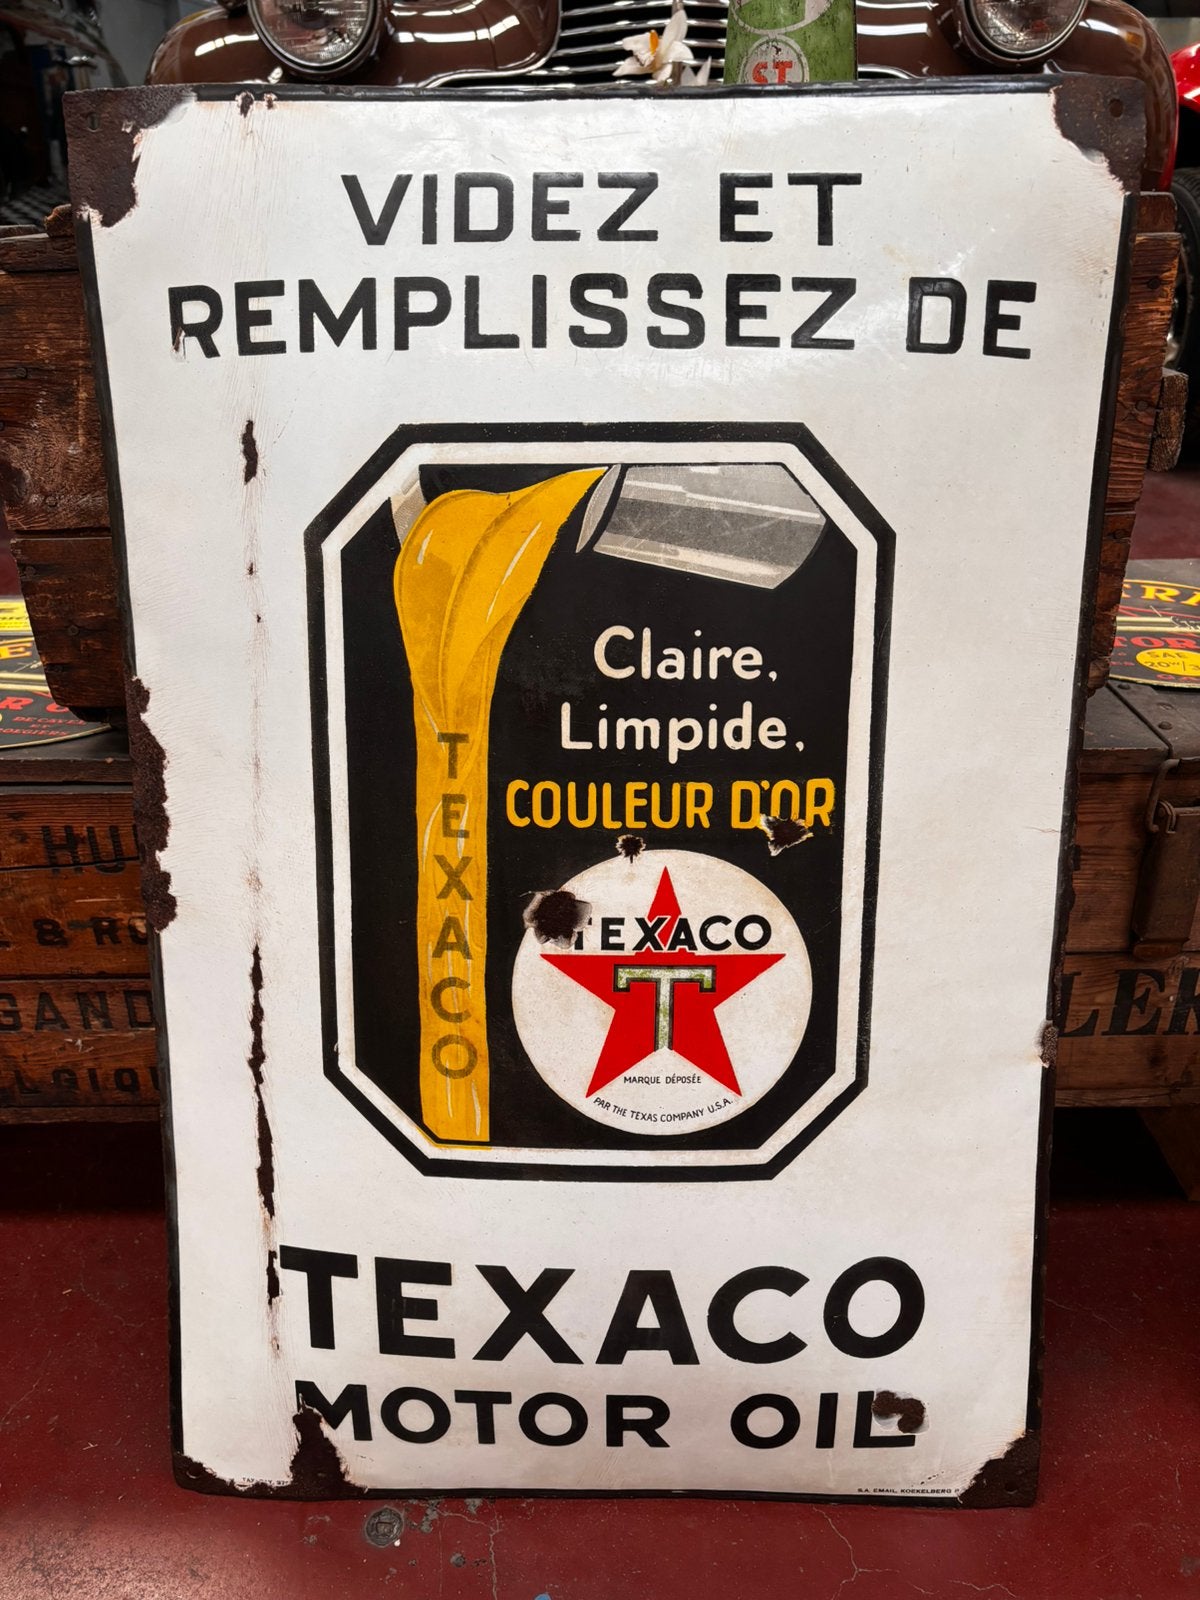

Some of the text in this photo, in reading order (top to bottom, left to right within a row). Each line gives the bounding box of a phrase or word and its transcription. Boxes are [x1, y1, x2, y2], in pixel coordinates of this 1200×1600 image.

[341, 172, 862, 246] VIDEZ ET
[168, 273, 1037, 360] REMPLISSEZ DE
[593, 625, 778, 682] Claire,
[560, 700, 804, 764] Limpide,
[506, 778, 835, 830] COULEUR D'OR
[41, 824, 140, 874] HU
[33, 918, 68, 947] &
[430, 732, 478, 1080] TEXACO
[613, 963, 717, 1052] T
[593, 1097, 734, 1122] PAR THE TEXAS COMPANY U.S.A.
[623, 1073, 702, 1085] MARQUE DÉPOSÉE
[278, 1245, 925, 1366] TEXACO
[294, 1380, 916, 1449] MOTOR OIL
